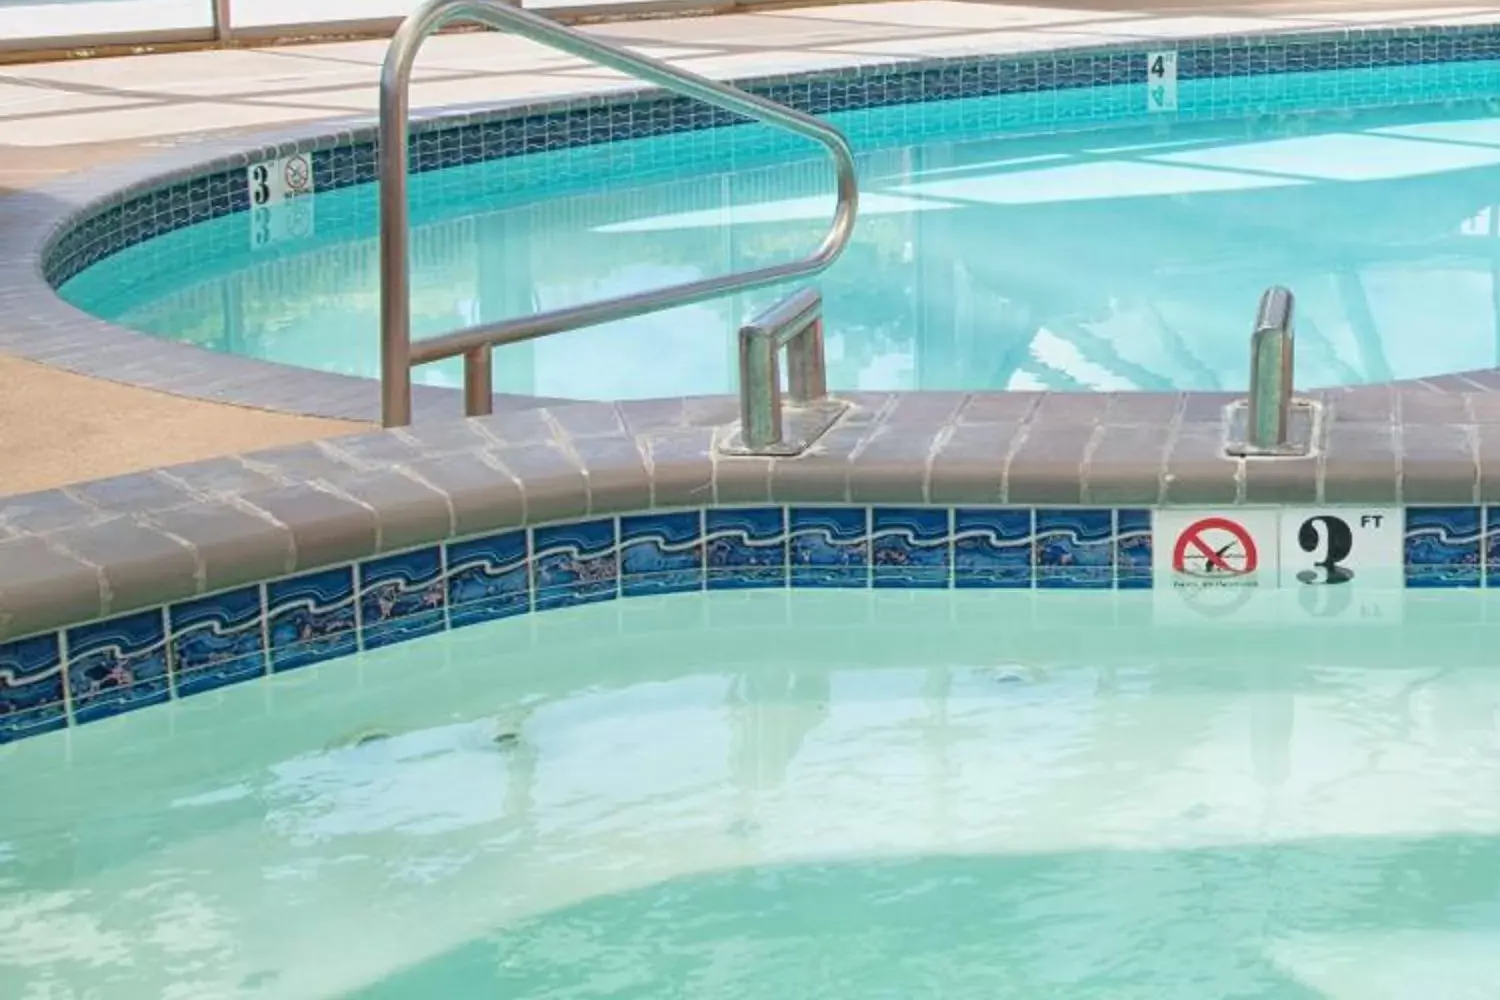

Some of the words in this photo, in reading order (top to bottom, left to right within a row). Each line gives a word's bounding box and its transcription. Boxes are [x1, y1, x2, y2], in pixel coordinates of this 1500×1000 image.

[1152, 56, 1165, 78] 4
[253, 165, 269, 204] 3
[1361, 515, 1384, 528] FT
